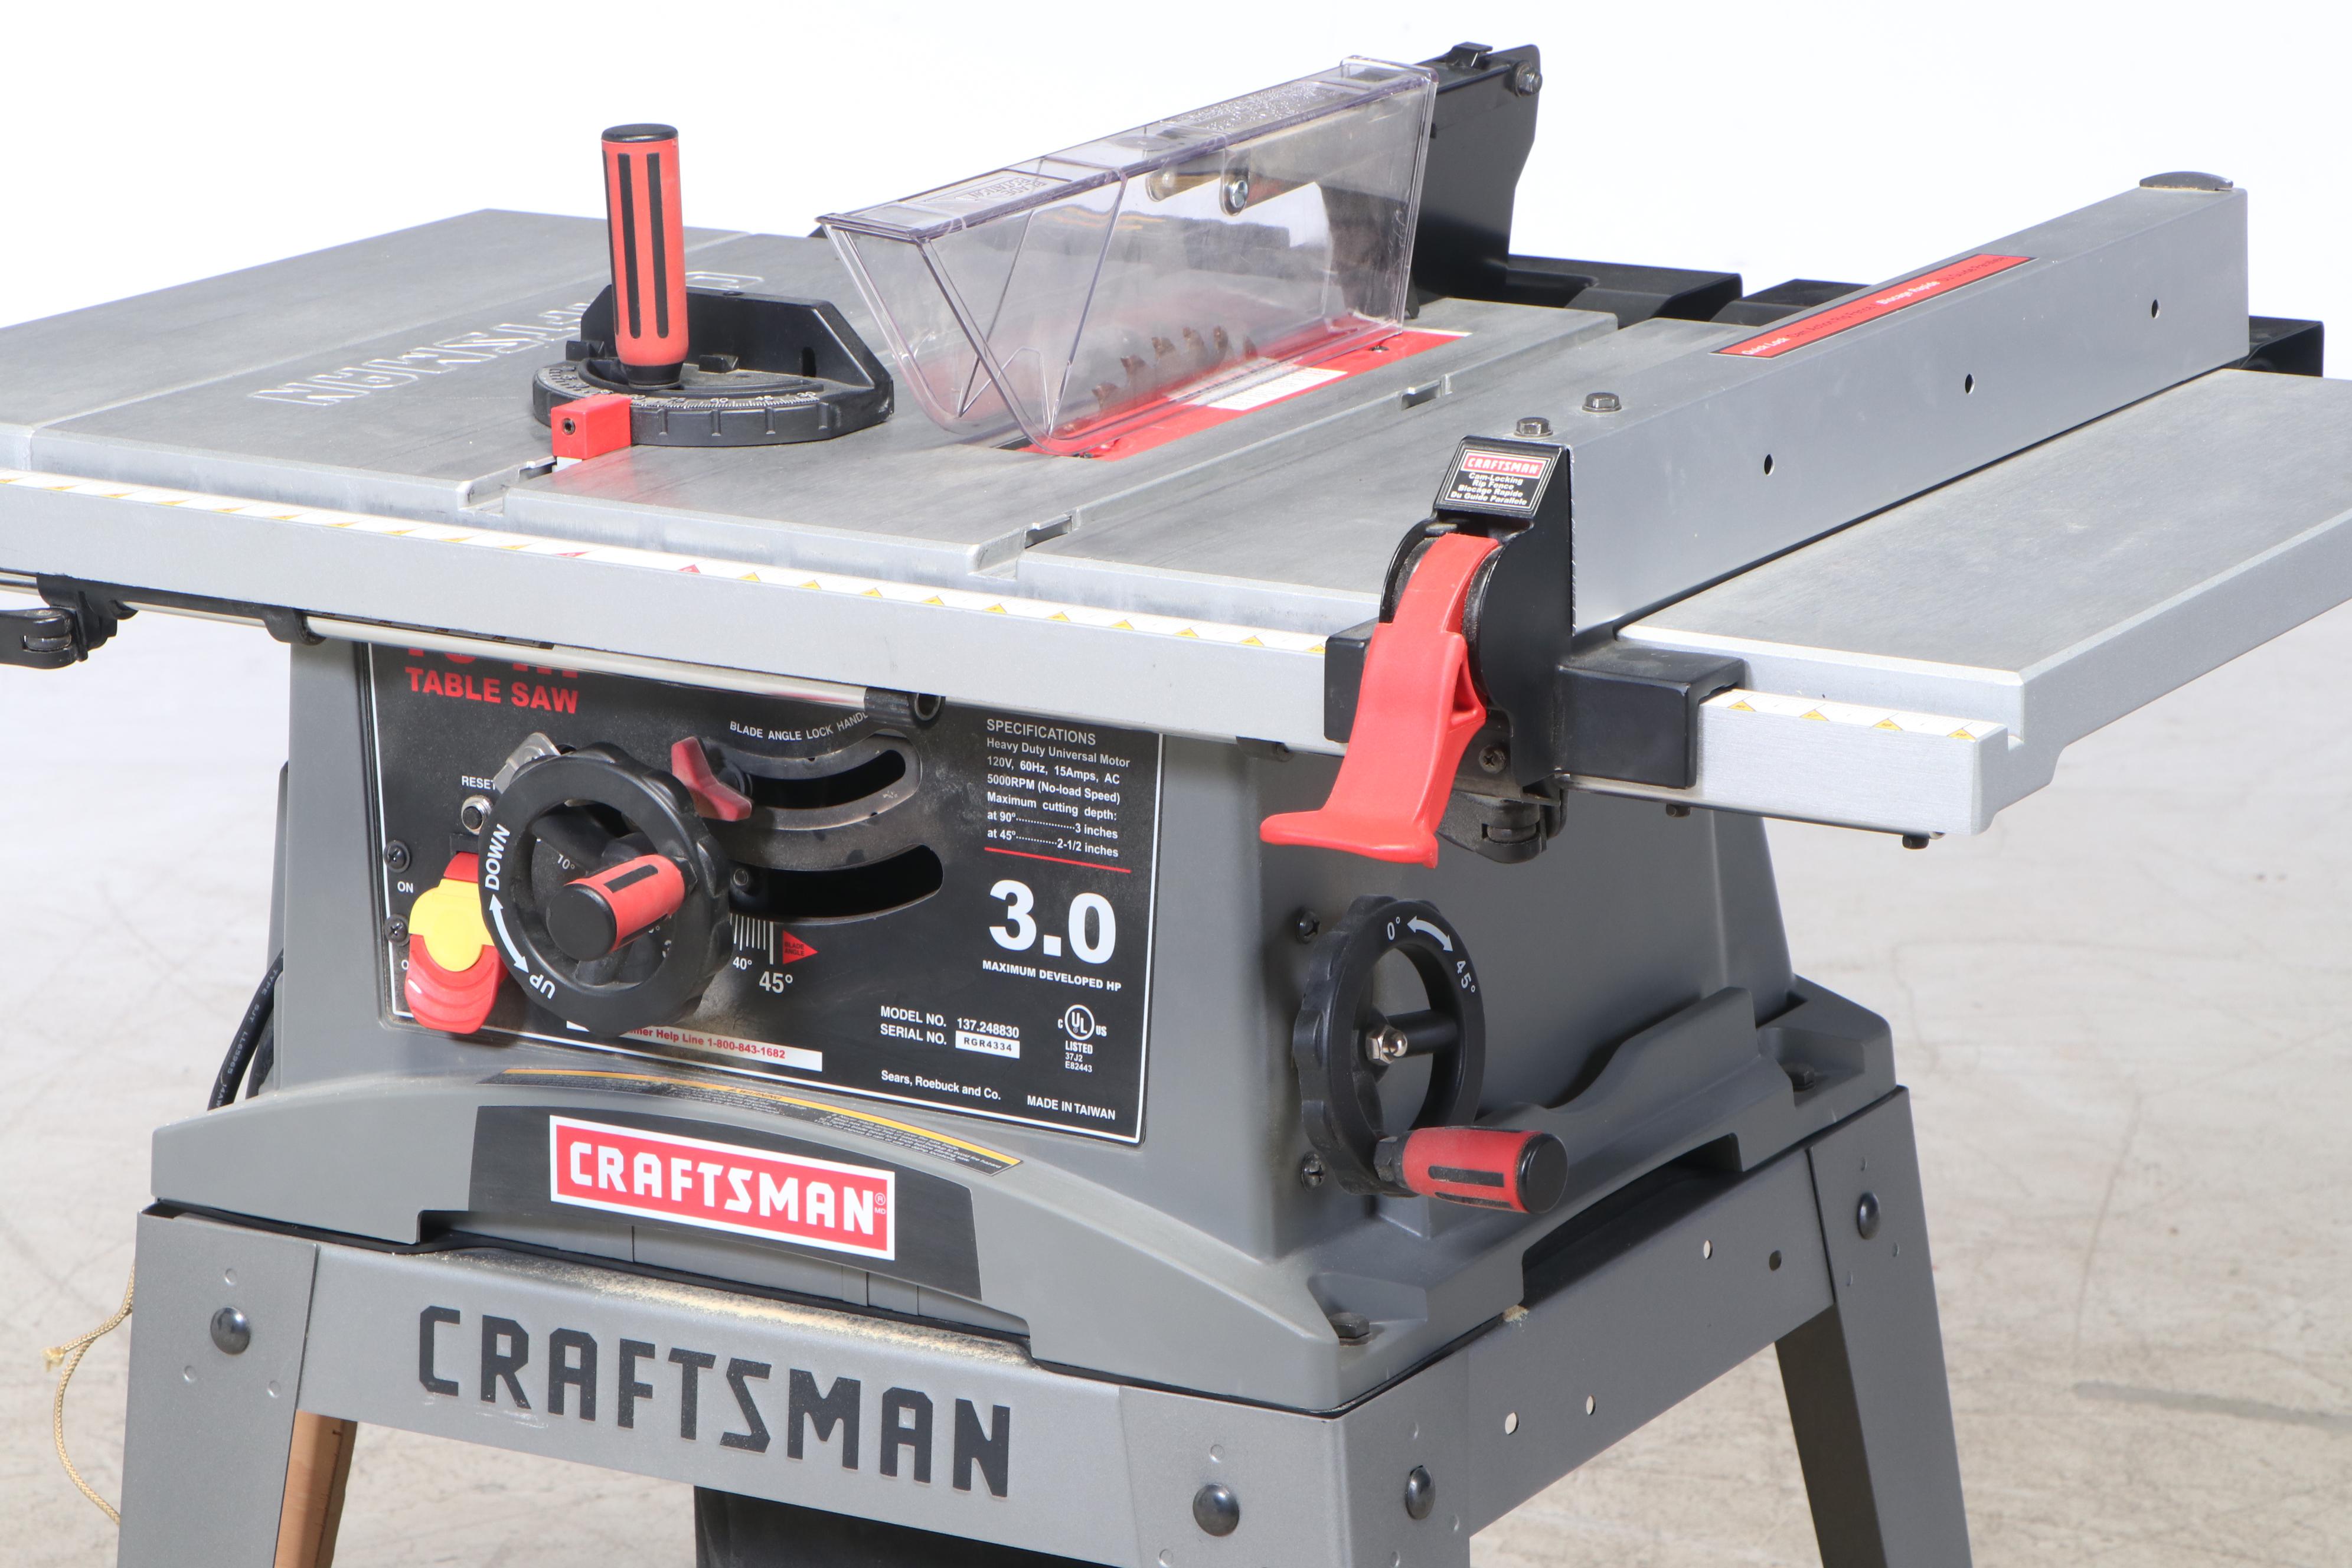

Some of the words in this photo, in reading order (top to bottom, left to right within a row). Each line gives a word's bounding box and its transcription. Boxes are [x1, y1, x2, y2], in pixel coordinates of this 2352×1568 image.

[1467, 458, 1539, 474] CRAFTSMAN
[1468, 472, 1524, 486] Cam-Locking
[1458, 484, 1492, 495] Blocage
[1494, 489, 1523, 498] Rapide
[1464, 492, 1488, 502] Guide
[1472, 479, 1487, 488] Rip
[1488, 481, 1514, 491] Fence
[405, 667, 501, 703] TABLE
[511, 682, 579, 714] SAW
[730, 721, 763, 738] BLADE
[768, 730, 802, 741] ANGLE
[806, 724, 834, 740] LOCK
[836, 711, 868, 732] HANDL
[986, 718, 1096, 746] SPECIFICATIONS
[986, 737, 1018, 753] Heavy
[1022, 742, 1045, 757] Duty
[1048, 746, 1096, 763] Universal
[1100, 754, 1130, 767] Motor
[462, 775, 495, 790] RESET
[987, 756, 1014, 770] 120V,
[1020, 760, 1048, 776] 60Hz,
[1054, 765, 1099, 783] 15Amps,
[1105, 773, 1120, 785] AC
[987, 773, 1035, 790] 5000RPM
[1038, 780, 1081, 797] (No-load
[1084, 788, 1121, 805] Speed)
[987, 791, 1037, 808] Maximum
[1043, 801, 1079, 817] cutting
[1084, 806, 1117, 821] depth:
[987, 811, 997, 820] at
[1084, 825, 1118, 839] inches
[987, 828, 998, 838] at
[1084, 842, 1119, 857] inches
[485, 823, 511, 891] DOWN
[397, 881, 414, 893] ON
[988, 879, 1118, 965] 3.0
[733, 956, 752, 970] 40°
[982, 960, 1037, 978] MAXIMUM
[1039, 969, 1103, 989] DEVELOPED
[1106, 981, 1122, 992] HP
[1456, 960, 1476, 993] 45°
[261, 968, 279, 996] TYPE
[529, 974, 556, 999] UP
[759, 971, 793, 994] 45°
[880, 1005, 923, 1024] MODEL
[926, 1012, 947, 1028] NO.
[957, 1017, 1020, 1039] 137.248830
[1072, 1011, 1087, 1034] UL
[1096, 1025, 1107, 1037] US
[656, 1029, 679, 1042] Help
[682, 1035, 704, 1045] Line
[707, 1038, 786, 1059] 1-800-843-1682
[880, 1023, 923, 1041] SERIAL
[926, 1031, 947, 1045] NO.
[963, 1036, 1013, 1053] RGR4334
[1065, 1040, 1093, 1054] LISTED
[1065, 1052, 1083, 1063] 37J2
[1065, 1061, 1092, 1073] E82443
[881, 1070, 913, 1087] Sears,
[915, 1075, 960, 1093] Roebuck
[962, 1083, 981, 1096] and
[984, 1086, 1001, 1100] Co.
[1027, 1095, 1059, 1111] MADE
[1061, 1100, 1072, 1113] IN
[1074, 1103, 1116, 1121] TAIWAN
[570, 1141, 874, 1236] CRAFTSMAN
[874, 1207, 886, 1215] MD
[419, 1305, 1011, 1498] CRAFTSMAN
